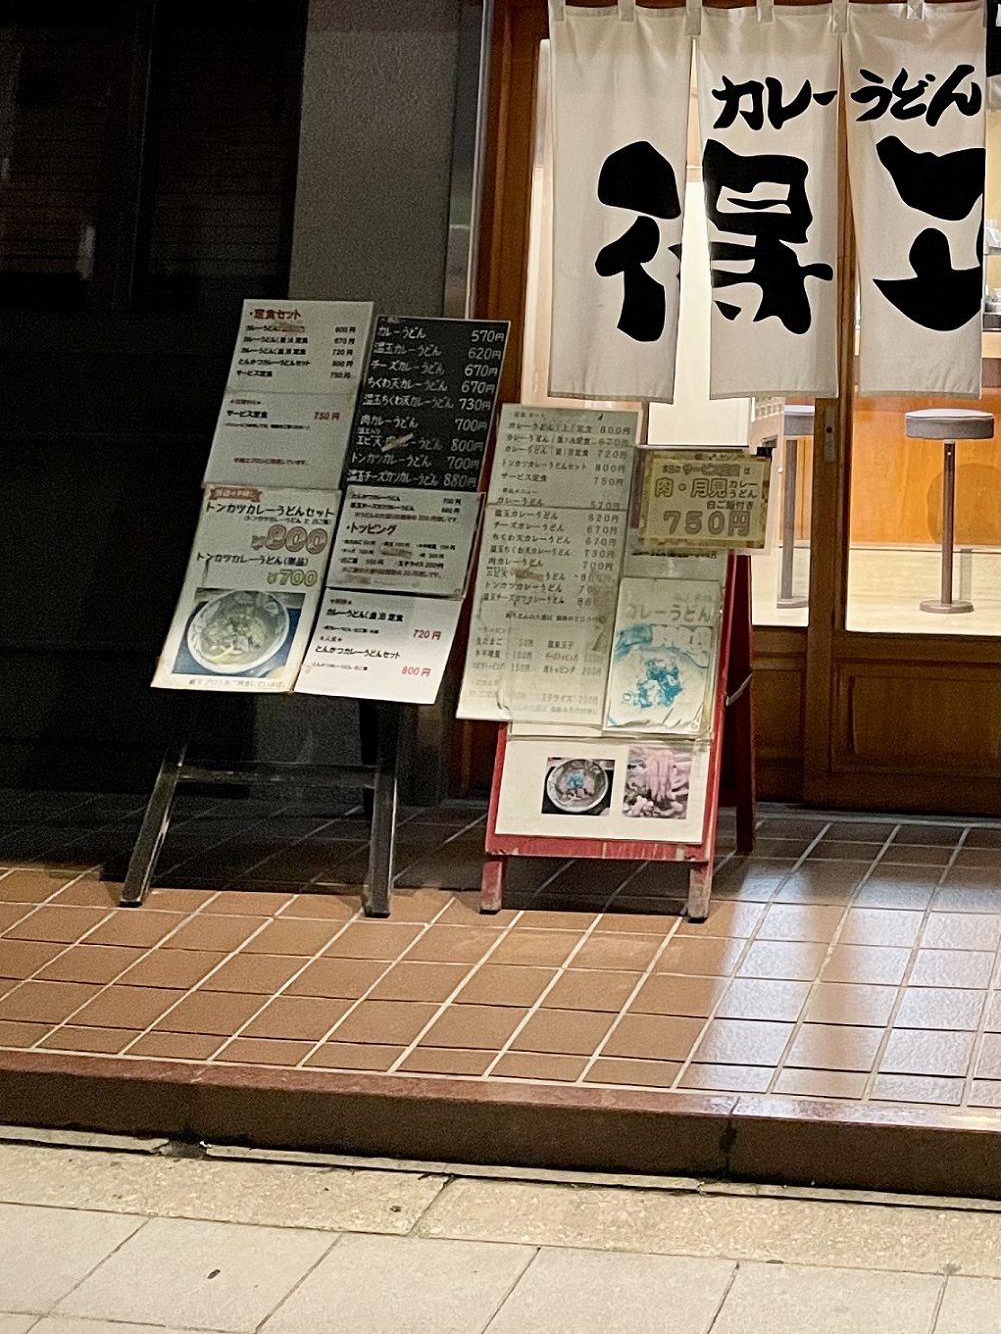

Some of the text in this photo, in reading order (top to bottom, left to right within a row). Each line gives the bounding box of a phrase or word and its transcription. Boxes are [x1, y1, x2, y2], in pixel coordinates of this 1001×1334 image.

[712, 64, 982, 130] カレーうどん
[378, 326, 504, 343] カレーうどん 570円
[373, 342, 501, 360] 温玉カレーうどん 620円
[370, 360, 498, 377] チーズカレーうどん 670円
[367, 377, 495, 394] ちくわ天カレーうどん 670円
[458, 398, 491, 411] 730円
[360, 415, 487, 431] 肉カレーうどん 700円
[450, 439, 483, 452] 800円
[352, 452, 479, 469] トンカツカレーうどん 700円
[443, 475, 477, 487] 880円
[594, 476, 624, 486] 750円
[730, 490, 758, 499] うどん
[205, 502, 335, 517] トンカツカレーうどんセット
[493, 522, 565, 532] チーズカレーうどん
[663, 511, 751, 537] 750円
[412, 629, 442, 640] 720円
[401, 666, 431, 677] 800円
